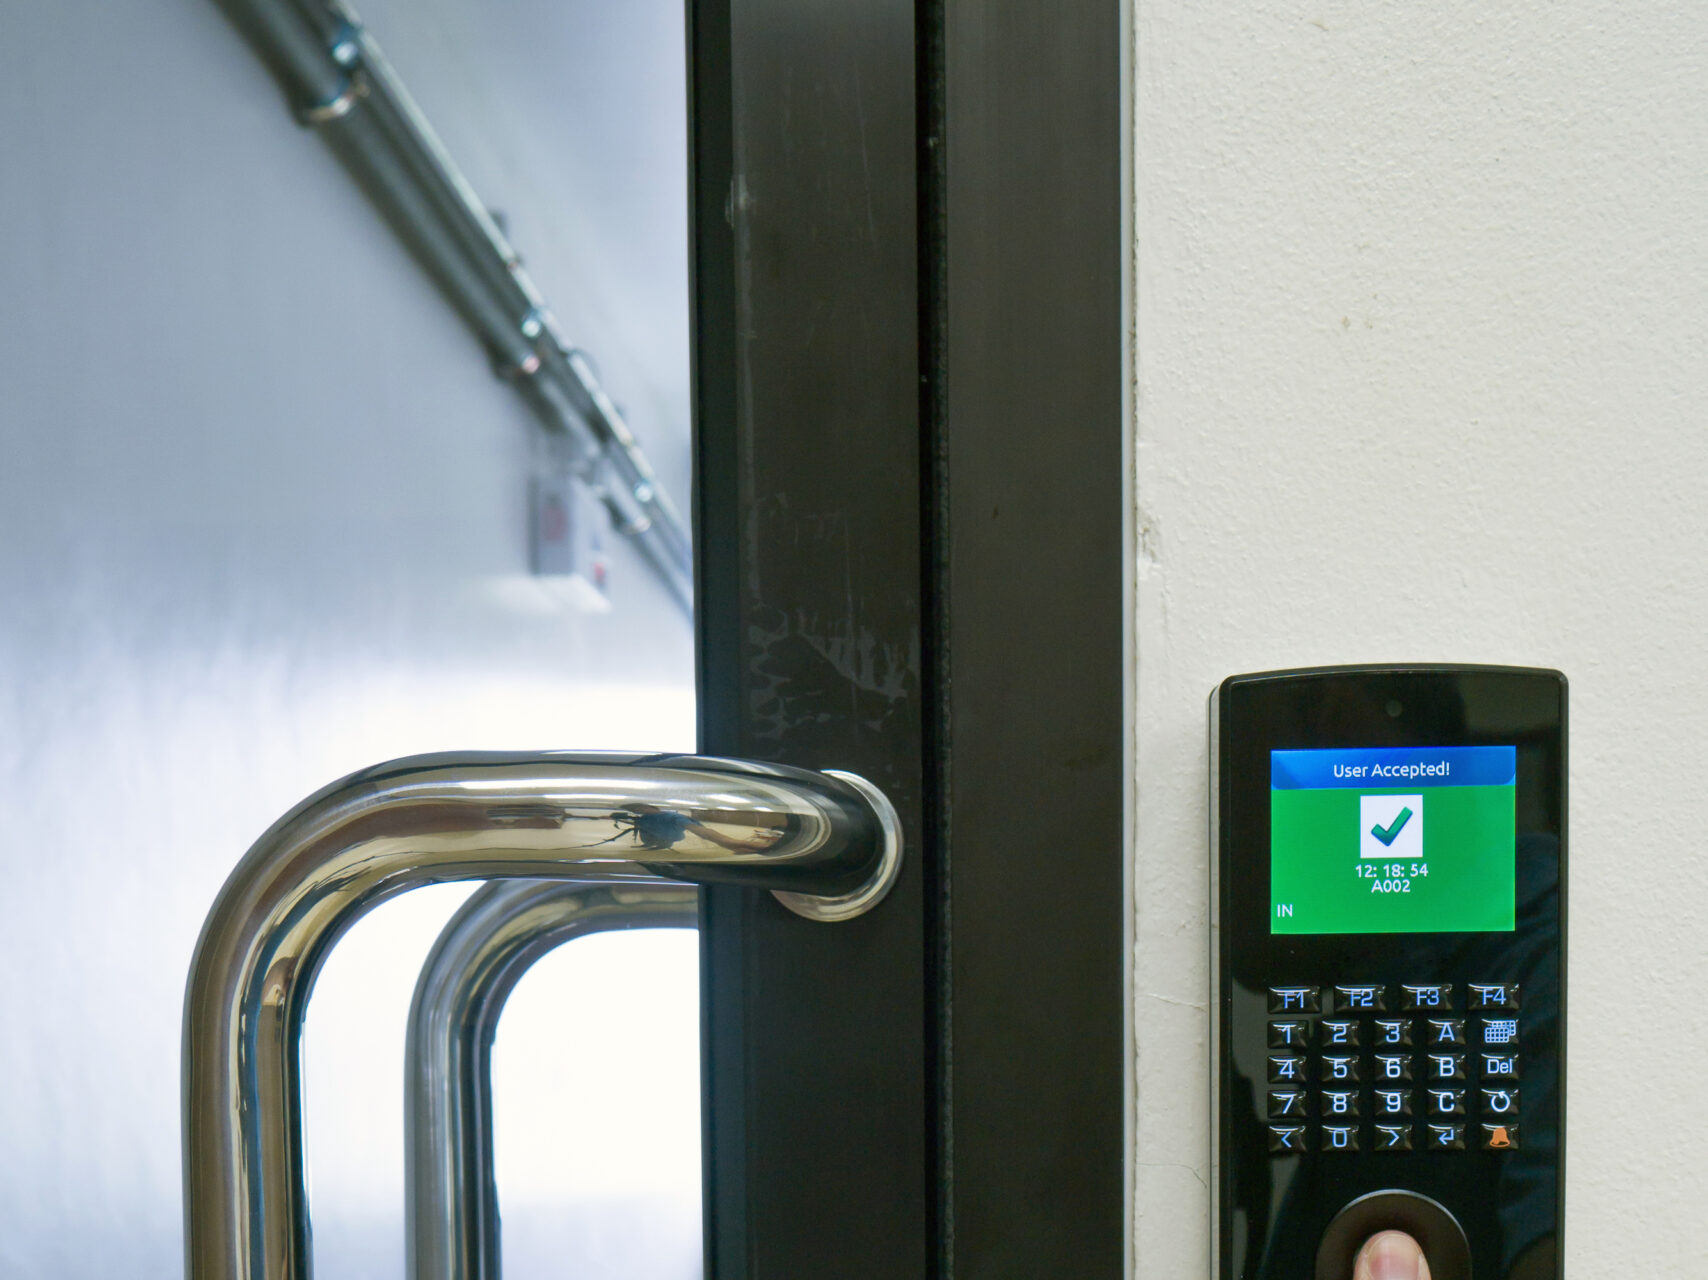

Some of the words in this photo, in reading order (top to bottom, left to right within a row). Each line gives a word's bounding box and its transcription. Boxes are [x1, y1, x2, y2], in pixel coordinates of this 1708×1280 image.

[1333, 763, 1368, 778] User
[1370, 761, 1450, 779] Accepted!
[1371, 879, 1411, 893] A002
[1276, 904, 1293, 917] IN
[1283, 991, 1305, 1009] F1
[1350, 989, 1374, 1007] F2
[1416, 988, 1440, 1006] F3
[1482, 987, 1507, 1005] F4
[1282, 1025, 1291, 1044] 1
[1333, 1024, 1347, 1043] 2
[1385, 1024, 1400, 1043] 3
[1438, 1022, 1455, 1041] A
[1279, 1060, 1295, 1079] 4
[1333, 1059, 1347, 1078] 5
[1386, 1058, 1401, 1078] 6
[1439, 1057, 1455, 1077] B
[1487, 1058, 1513, 1074] Del
[1281, 1094, 1295, 1114] 7
[1333, 1093, 1347, 1113] 8
[1386, 1092, 1401, 1112] 9
[1439, 1092, 1455, 1112] C
